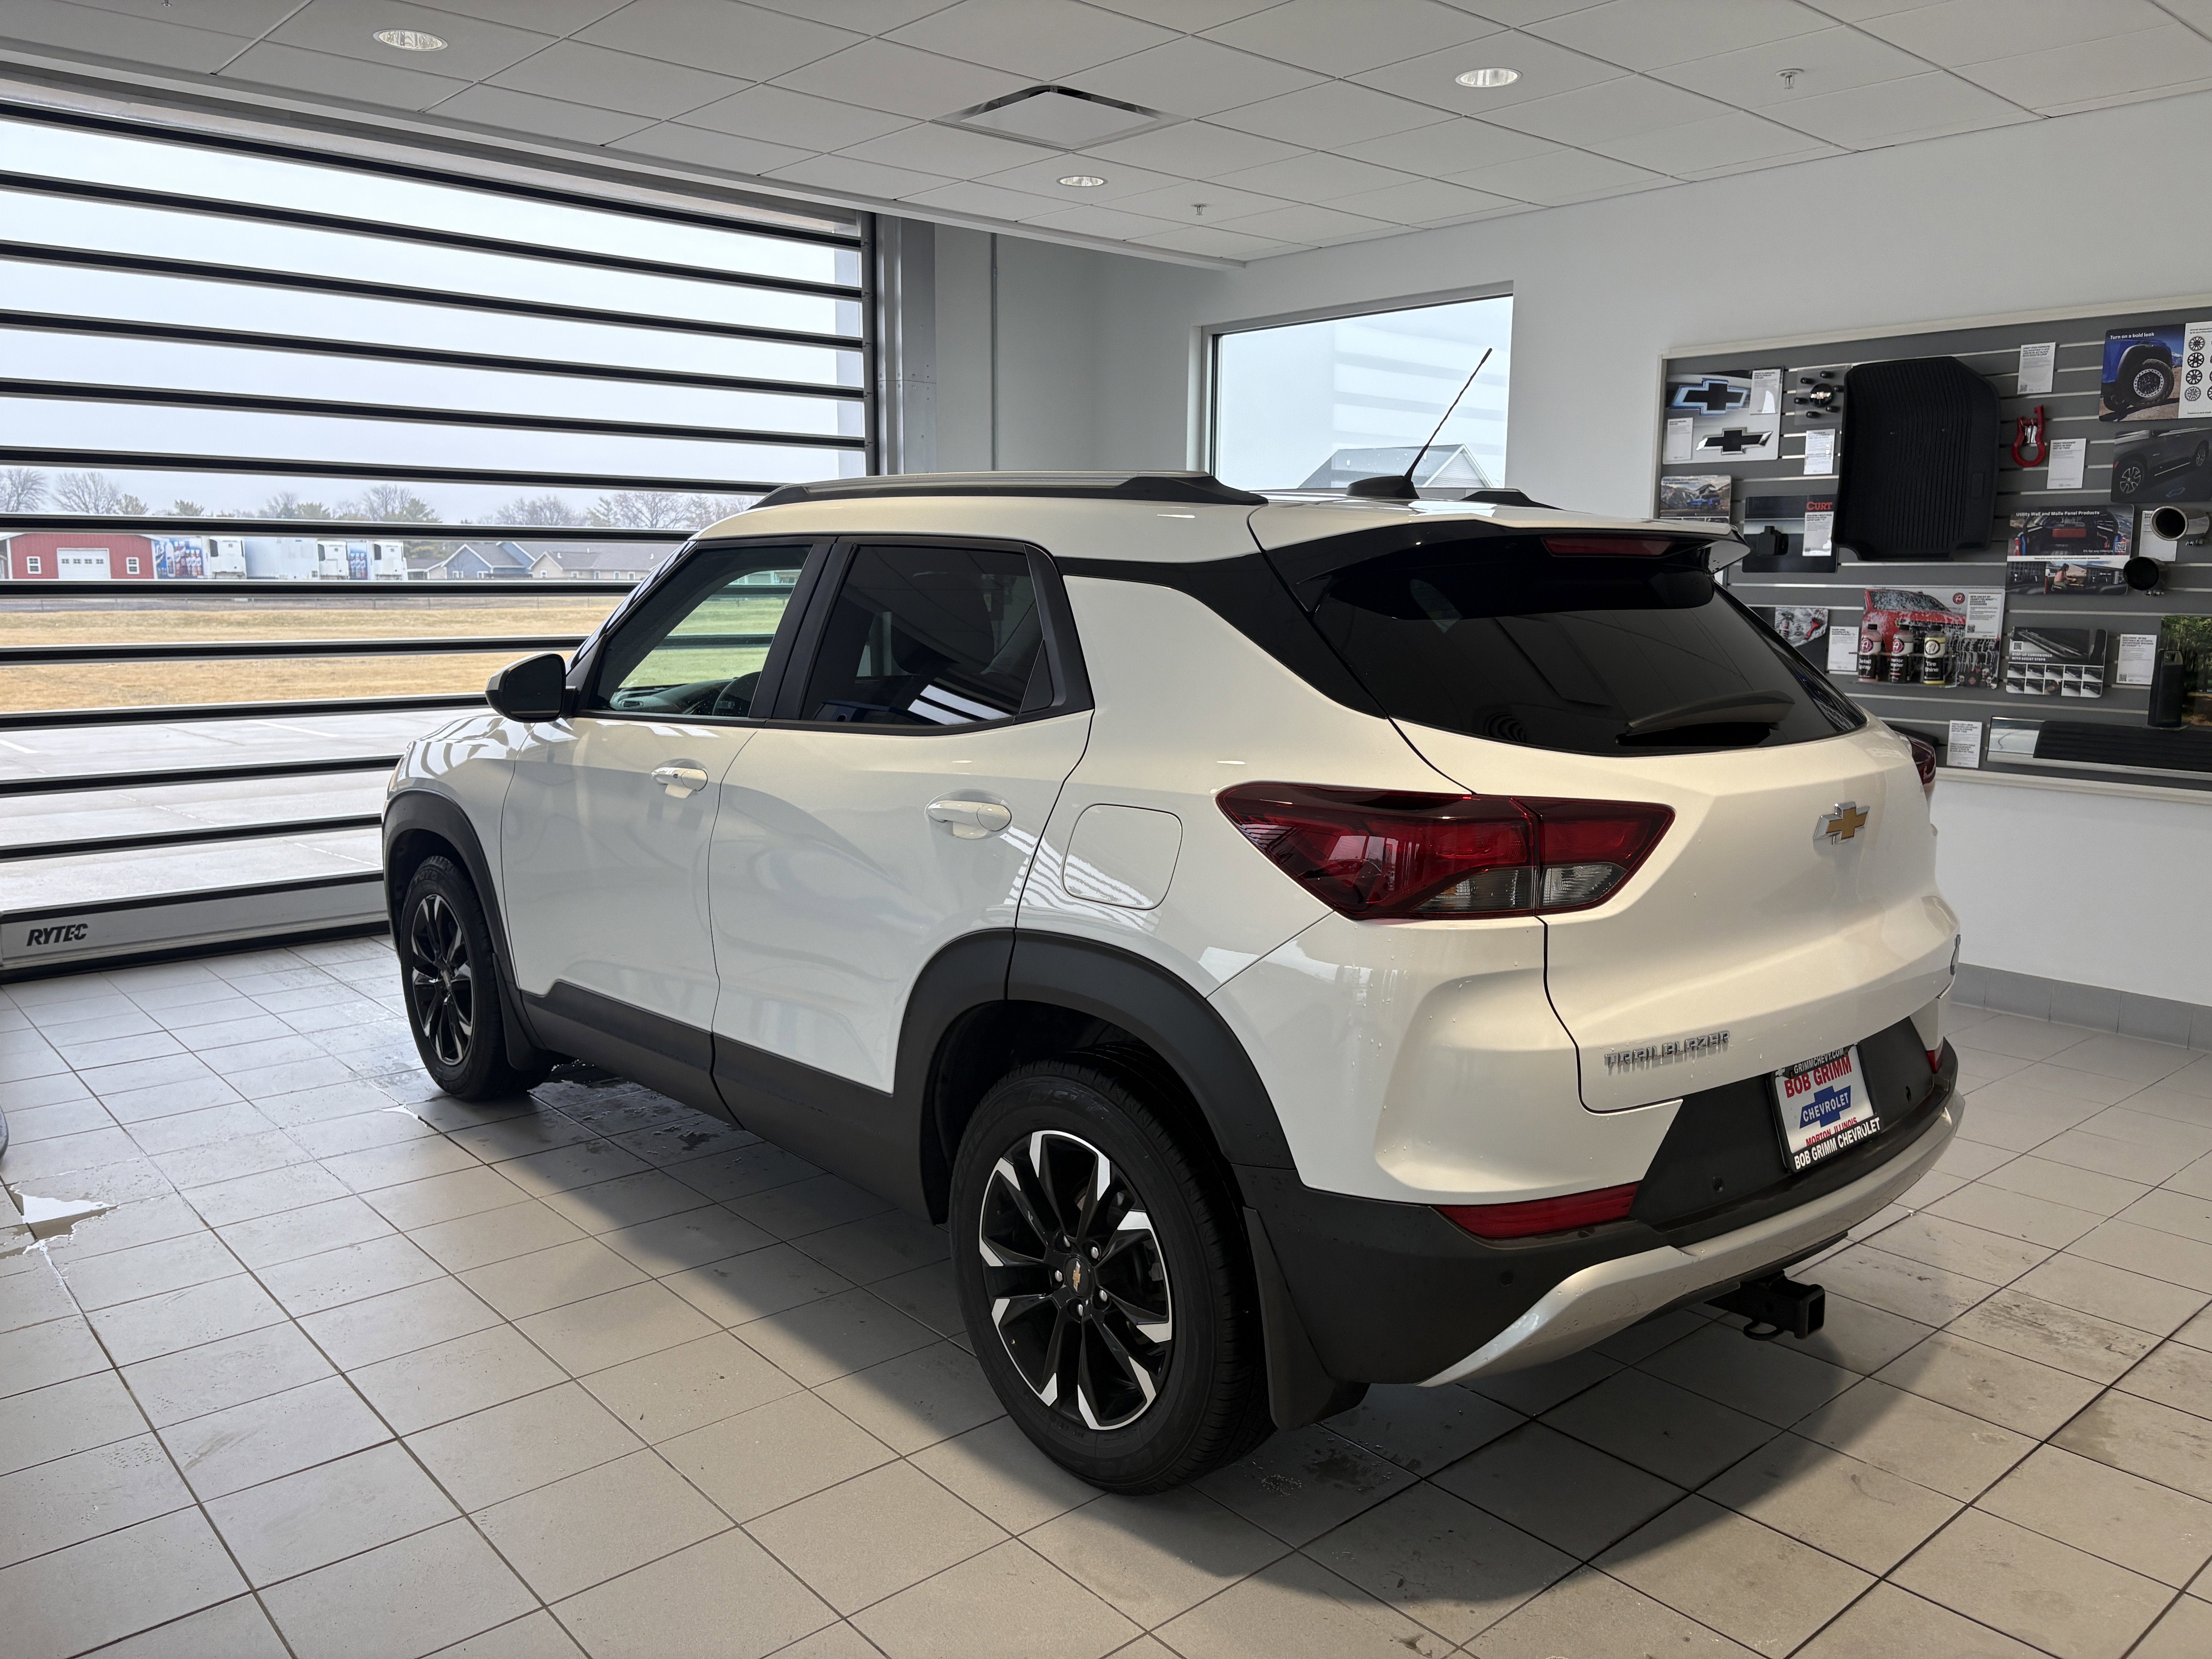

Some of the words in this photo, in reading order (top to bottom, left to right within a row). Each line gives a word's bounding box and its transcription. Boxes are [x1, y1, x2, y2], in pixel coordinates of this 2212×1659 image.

[1806, 501, 1833, 511] CURT
[26, 924, 88, 946] RYTEC
[1604, 1030, 1730, 1068] TRAILBLAZER
[1794, 1048, 1844, 1074] GRIMMCHEVY.COM
[1784, 1073, 1811, 1098] BOB
[1813, 1055, 1852, 1086] GRIMM
[1803, 1092, 1849, 1122] CHEVROLET
[1794, 1150, 1811, 1170] BOB
[1811, 1138, 1838, 1161] GRIMM
[1838, 1117, 1880, 1148] CHEVROLET
